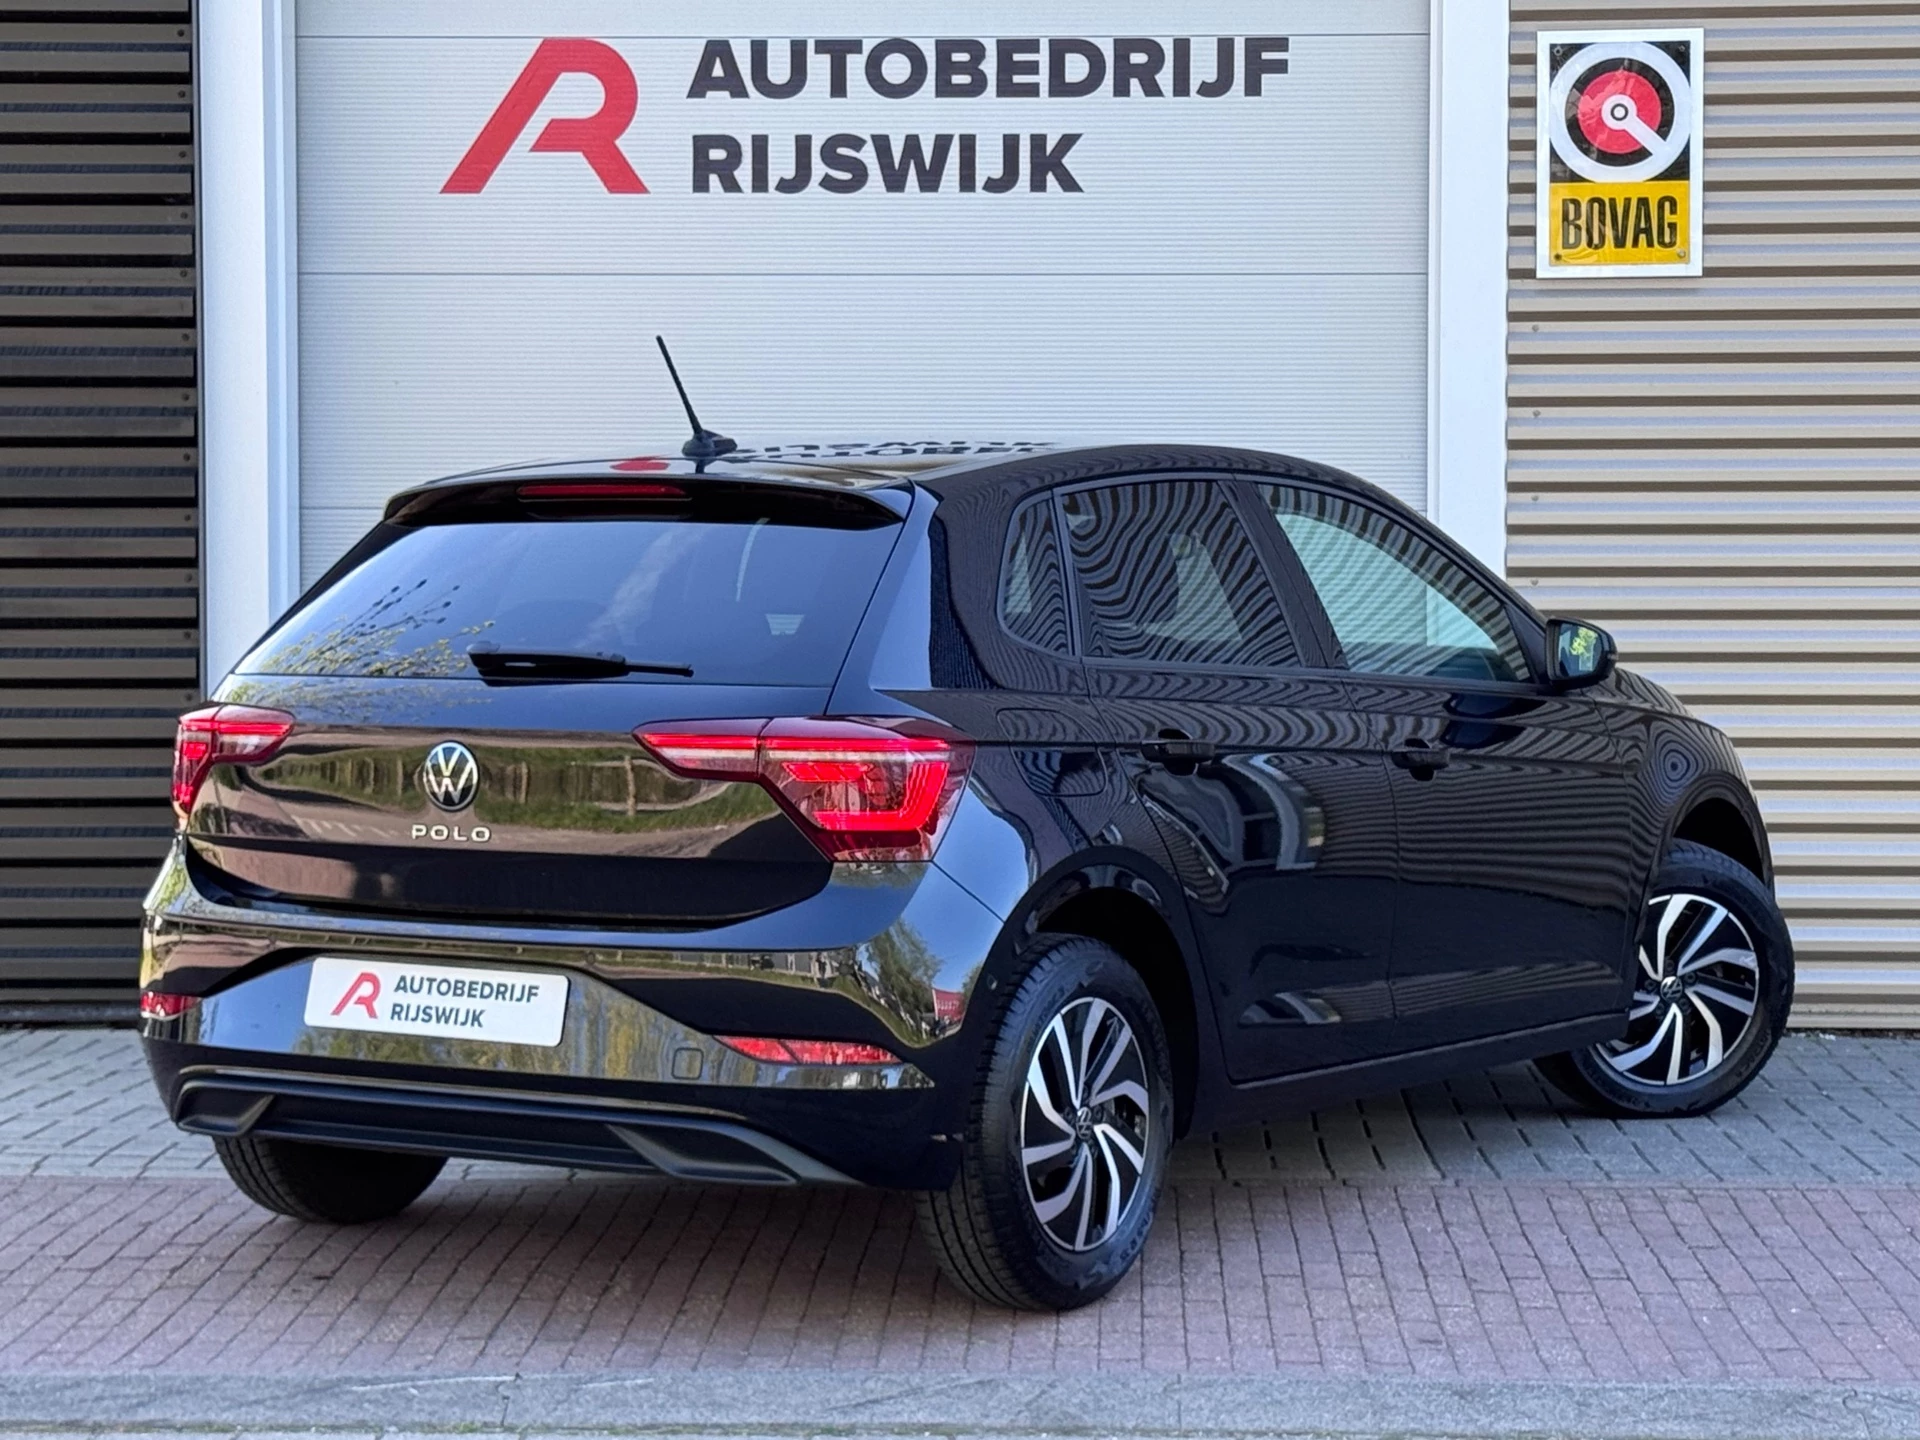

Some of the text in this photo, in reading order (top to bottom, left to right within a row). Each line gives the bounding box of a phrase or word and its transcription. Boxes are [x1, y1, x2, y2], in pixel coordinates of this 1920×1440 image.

[687, 37, 1290, 99] AUTOBEDRIJF
[692, 133, 1084, 194] RIJSWIJK
[1561, 195, 1678, 250] BOVAG
[411, 824, 491, 842] POLO
[394, 975, 540, 1003] AUTOBEDRIJF
[390, 1003, 485, 1027] RIJSWIJK
